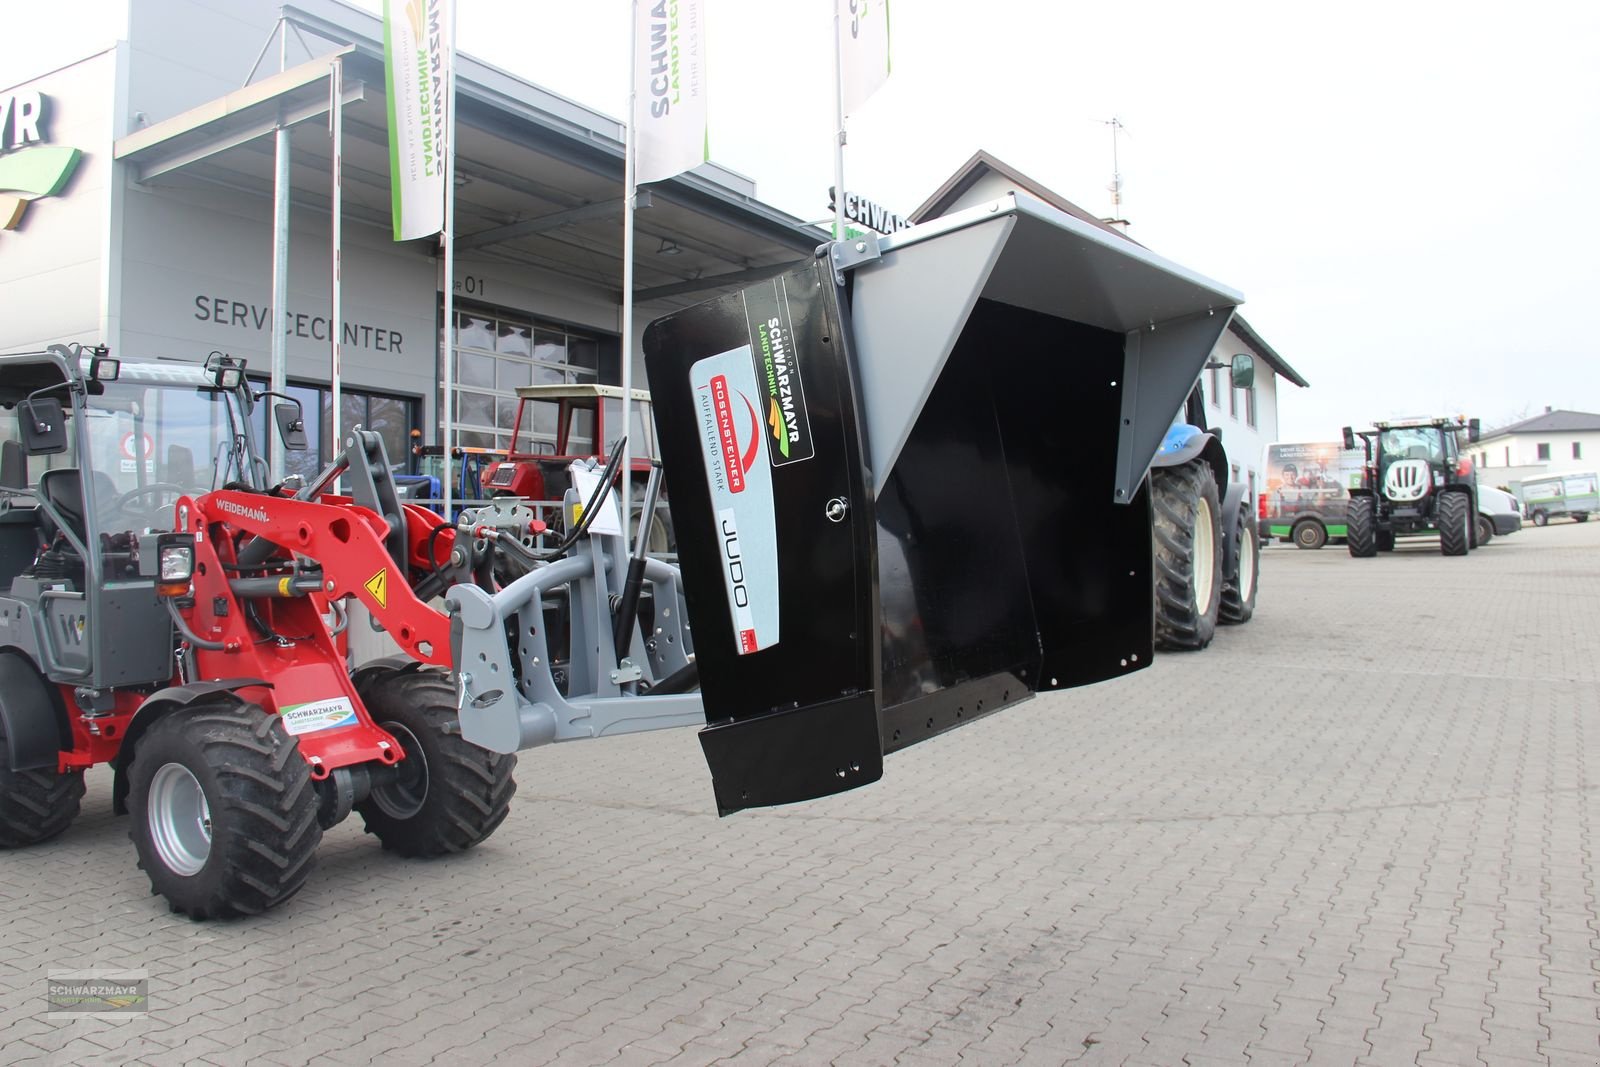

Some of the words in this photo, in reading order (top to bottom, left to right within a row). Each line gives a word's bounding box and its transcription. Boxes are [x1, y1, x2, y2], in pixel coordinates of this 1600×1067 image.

[689, 33, 697, 57] ALS
[689, 63, 698, 97] MEHR
[465, 276, 484, 296] 01
[758, 323, 778, 397] LANDTECHNIK
[782, 328, 794, 374] EDITION
[768, 317, 800, 443] SCHWARZMAYR
[701, 394, 718, 456] AUFFALLEND
[711, 460, 724, 491] STARK
[714, 381, 741, 488] ROSENSTEINER
[216, 498, 265, 522] WEIDEMANN
[722, 519, 748, 608] JUDO
[287, 704, 343, 720] SCHWARZMAYR
